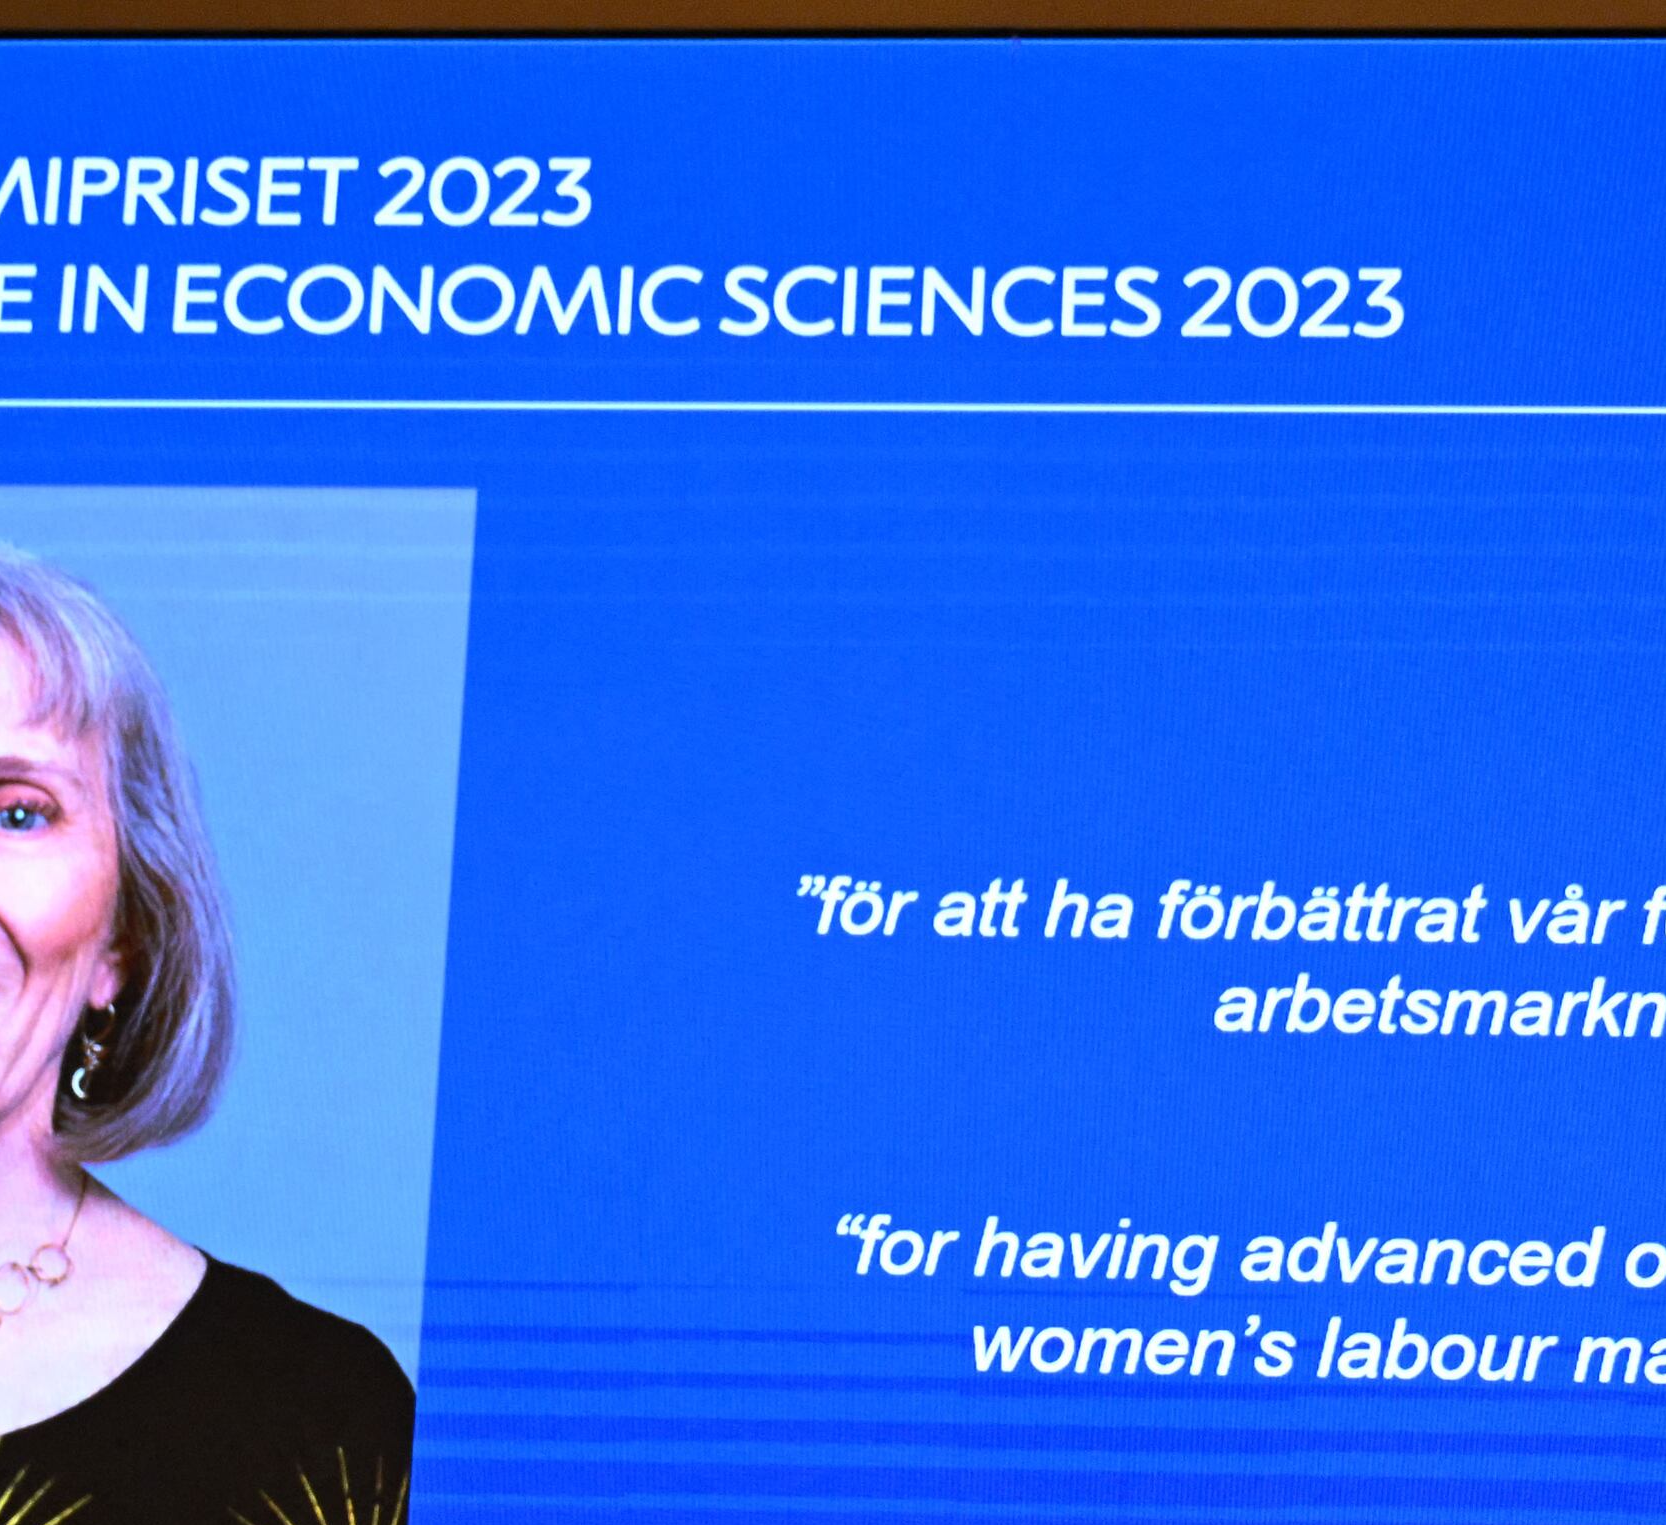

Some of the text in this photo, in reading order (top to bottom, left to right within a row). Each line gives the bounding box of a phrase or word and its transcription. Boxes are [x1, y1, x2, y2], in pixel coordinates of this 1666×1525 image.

[374, 157, 591, 226] 2023
[60, 265, 148, 332] IN
[173, 265, 702, 335] ECONOMIC
[720, 266, 1161, 337] SCIENCES
[1181, 267, 1404, 338] 2023
[934, 879, 1027, 937] att
[1045, 879, 1133, 938] ha
[1158, 880, 1487, 942] förbättrat
[1510, 884, 1626, 944] vår
[974, 1216, 1219, 1296] having
[1241, 1222, 1606, 1287] advanced
[974, 1315, 1296, 1377] women’s
[1317, 1317, 1558, 1381] labour
